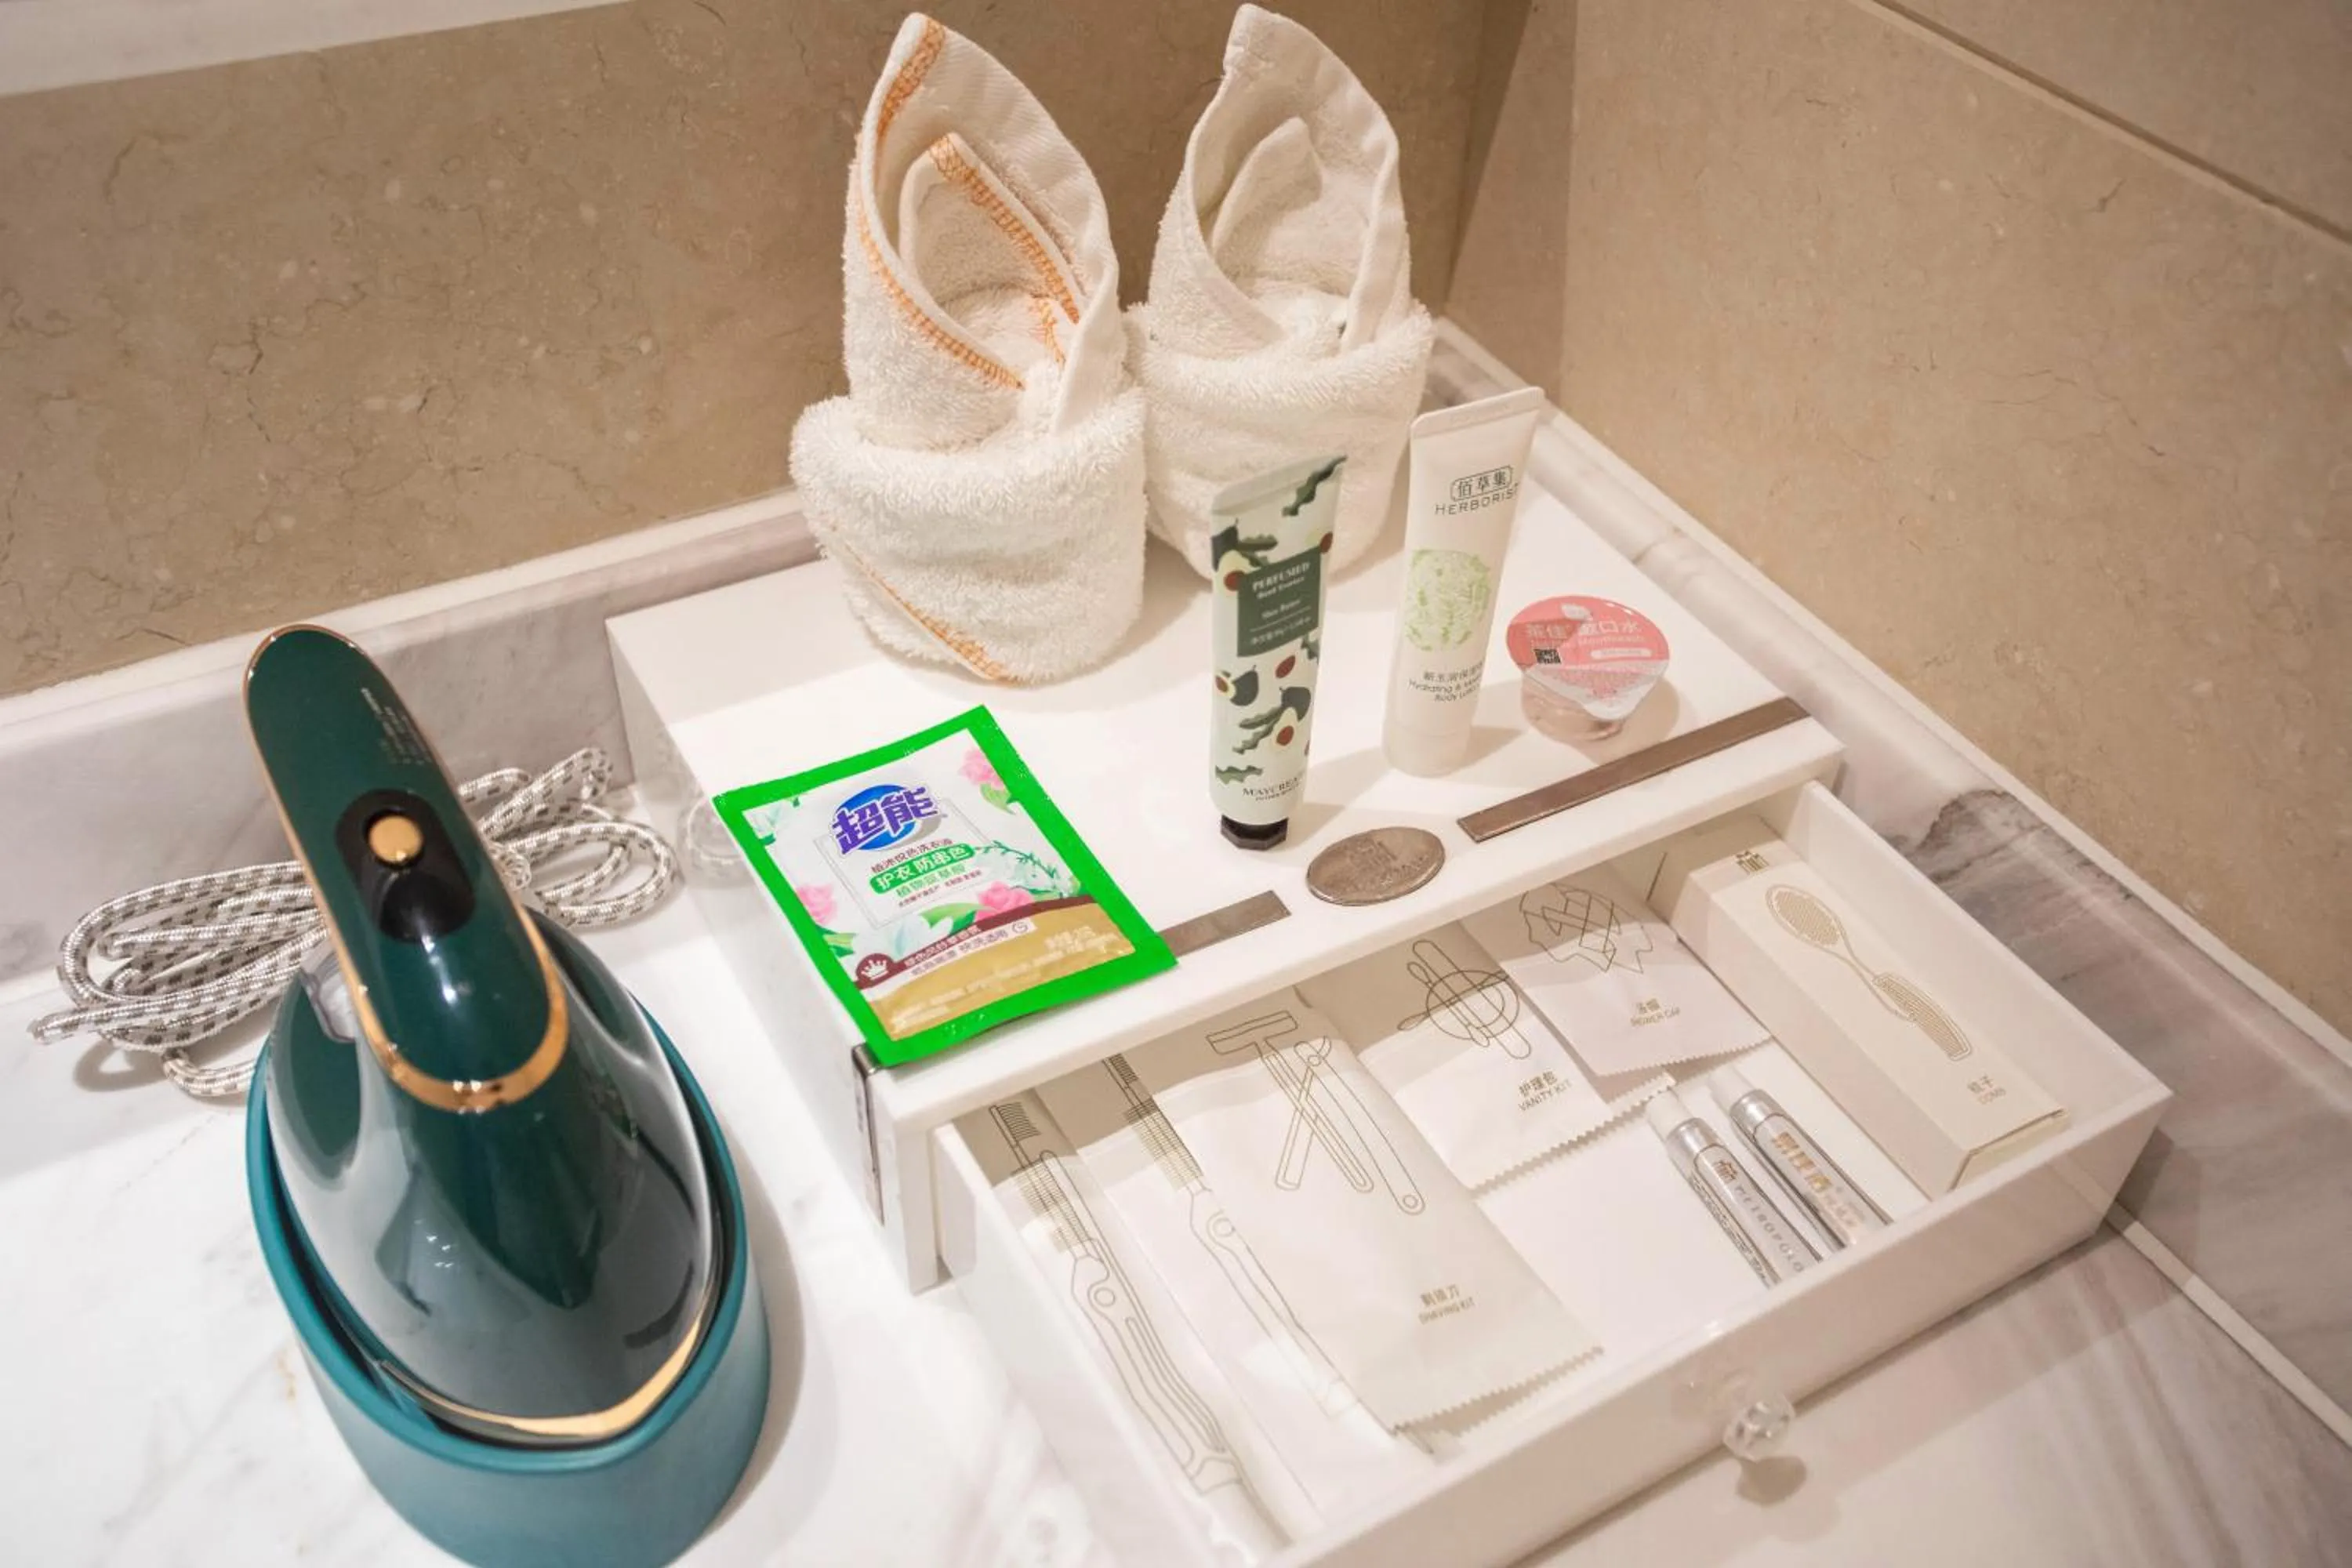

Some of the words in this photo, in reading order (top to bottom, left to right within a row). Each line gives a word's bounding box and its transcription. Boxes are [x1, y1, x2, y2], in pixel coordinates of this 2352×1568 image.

[1457, 470, 1507, 499] 佰草集
[1252, 562, 1310, 591] PERFUMED
[832, 786, 938, 855] 超能
[1519, 1070, 1558, 1098] 护理包
[1517, 1090, 1553, 1112] VANITY
